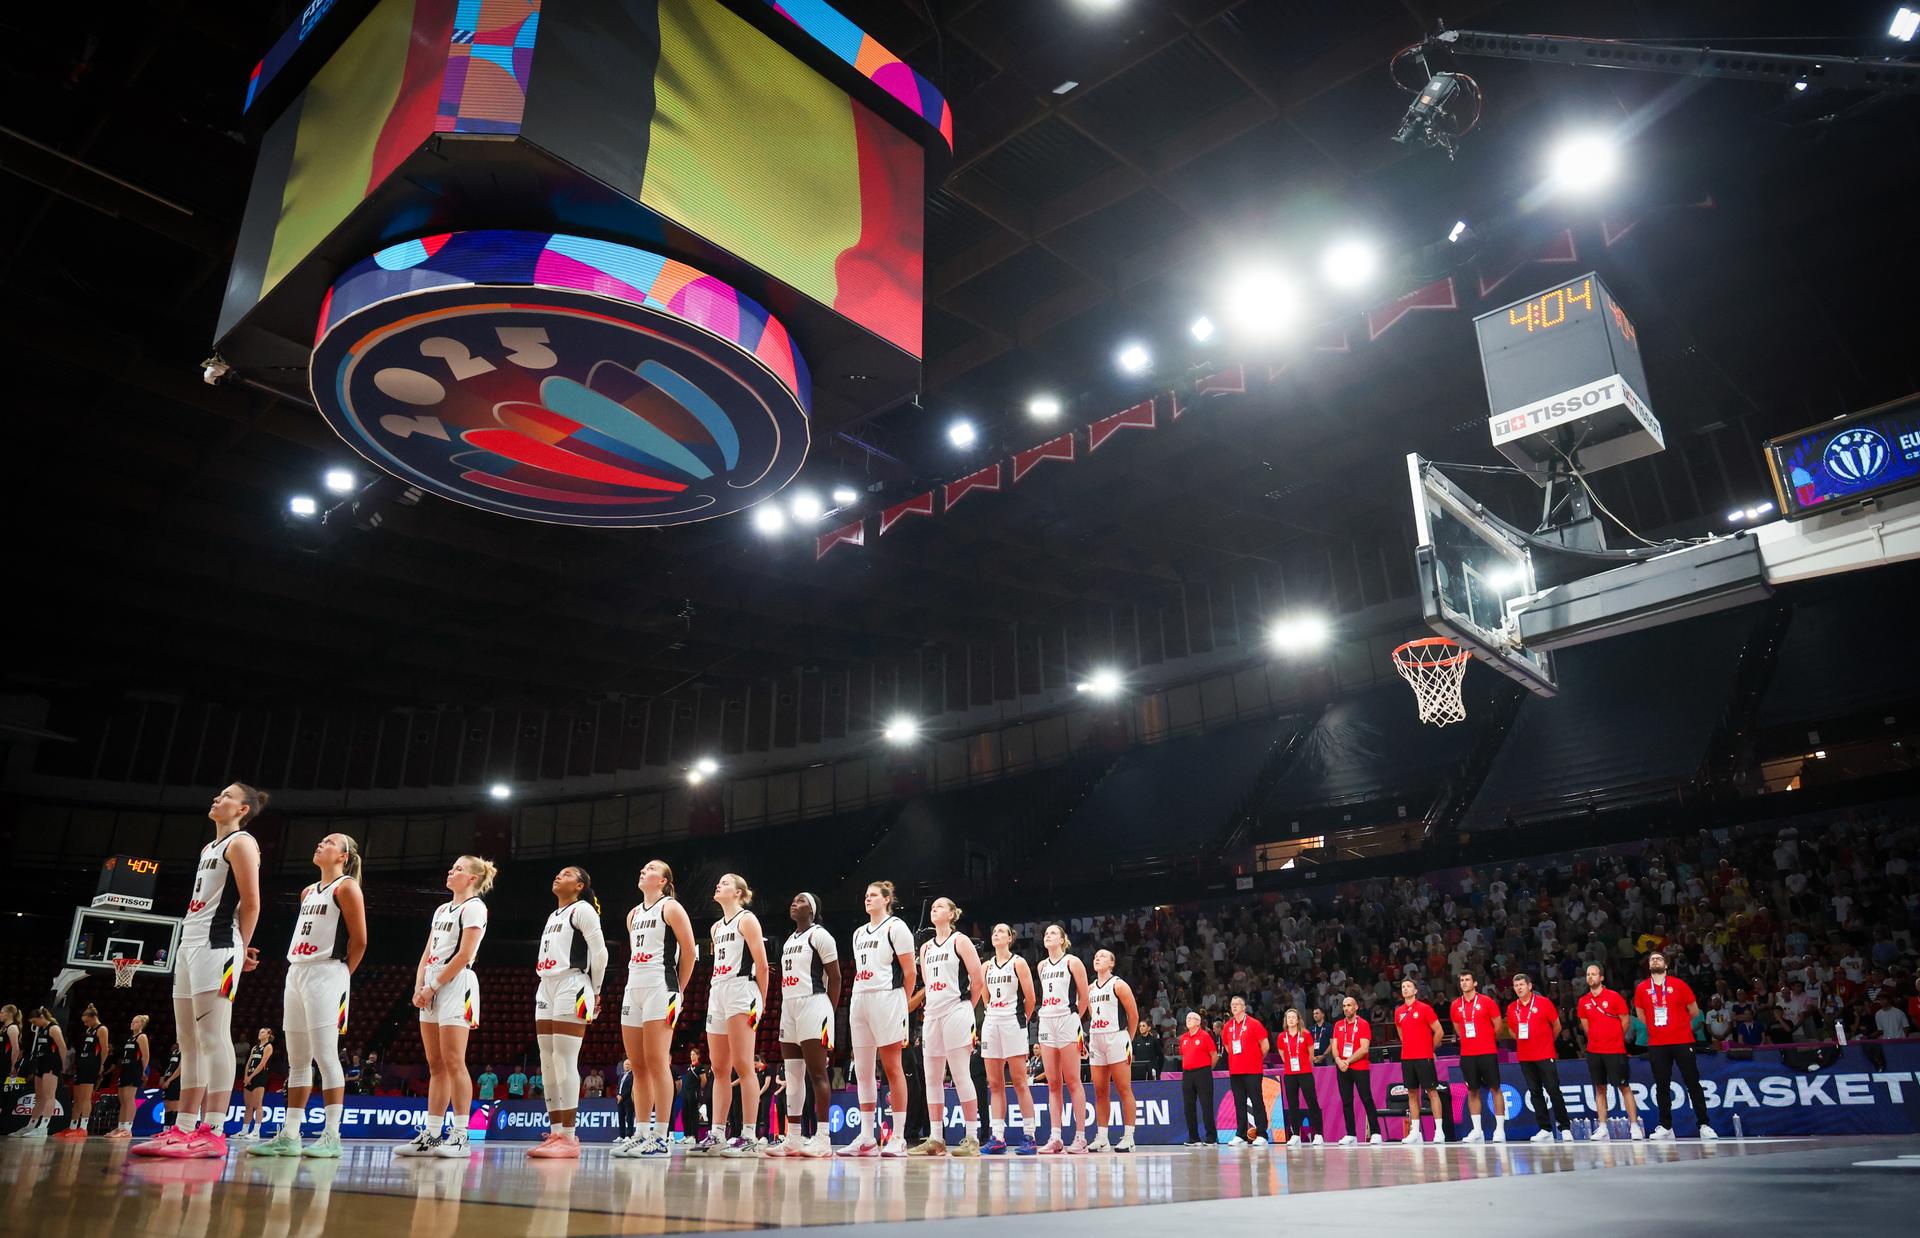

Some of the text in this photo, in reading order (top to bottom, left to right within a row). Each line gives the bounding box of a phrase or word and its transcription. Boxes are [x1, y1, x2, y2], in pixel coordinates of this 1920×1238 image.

[1509, 279, 1592, 332] 4:04
[1527, 384, 1616, 425] TISSOT
[127, 858, 158, 874] 4:04
[119, 897, 151, 908] TISSOT
[301, 921, 313, 935] 55
[635, 934, 645, 947] 27
[996, 988, 1001, 998] 6
[1048, 982, 1053, 992] 5
[1096, 1006, 1100, 1015] 4
